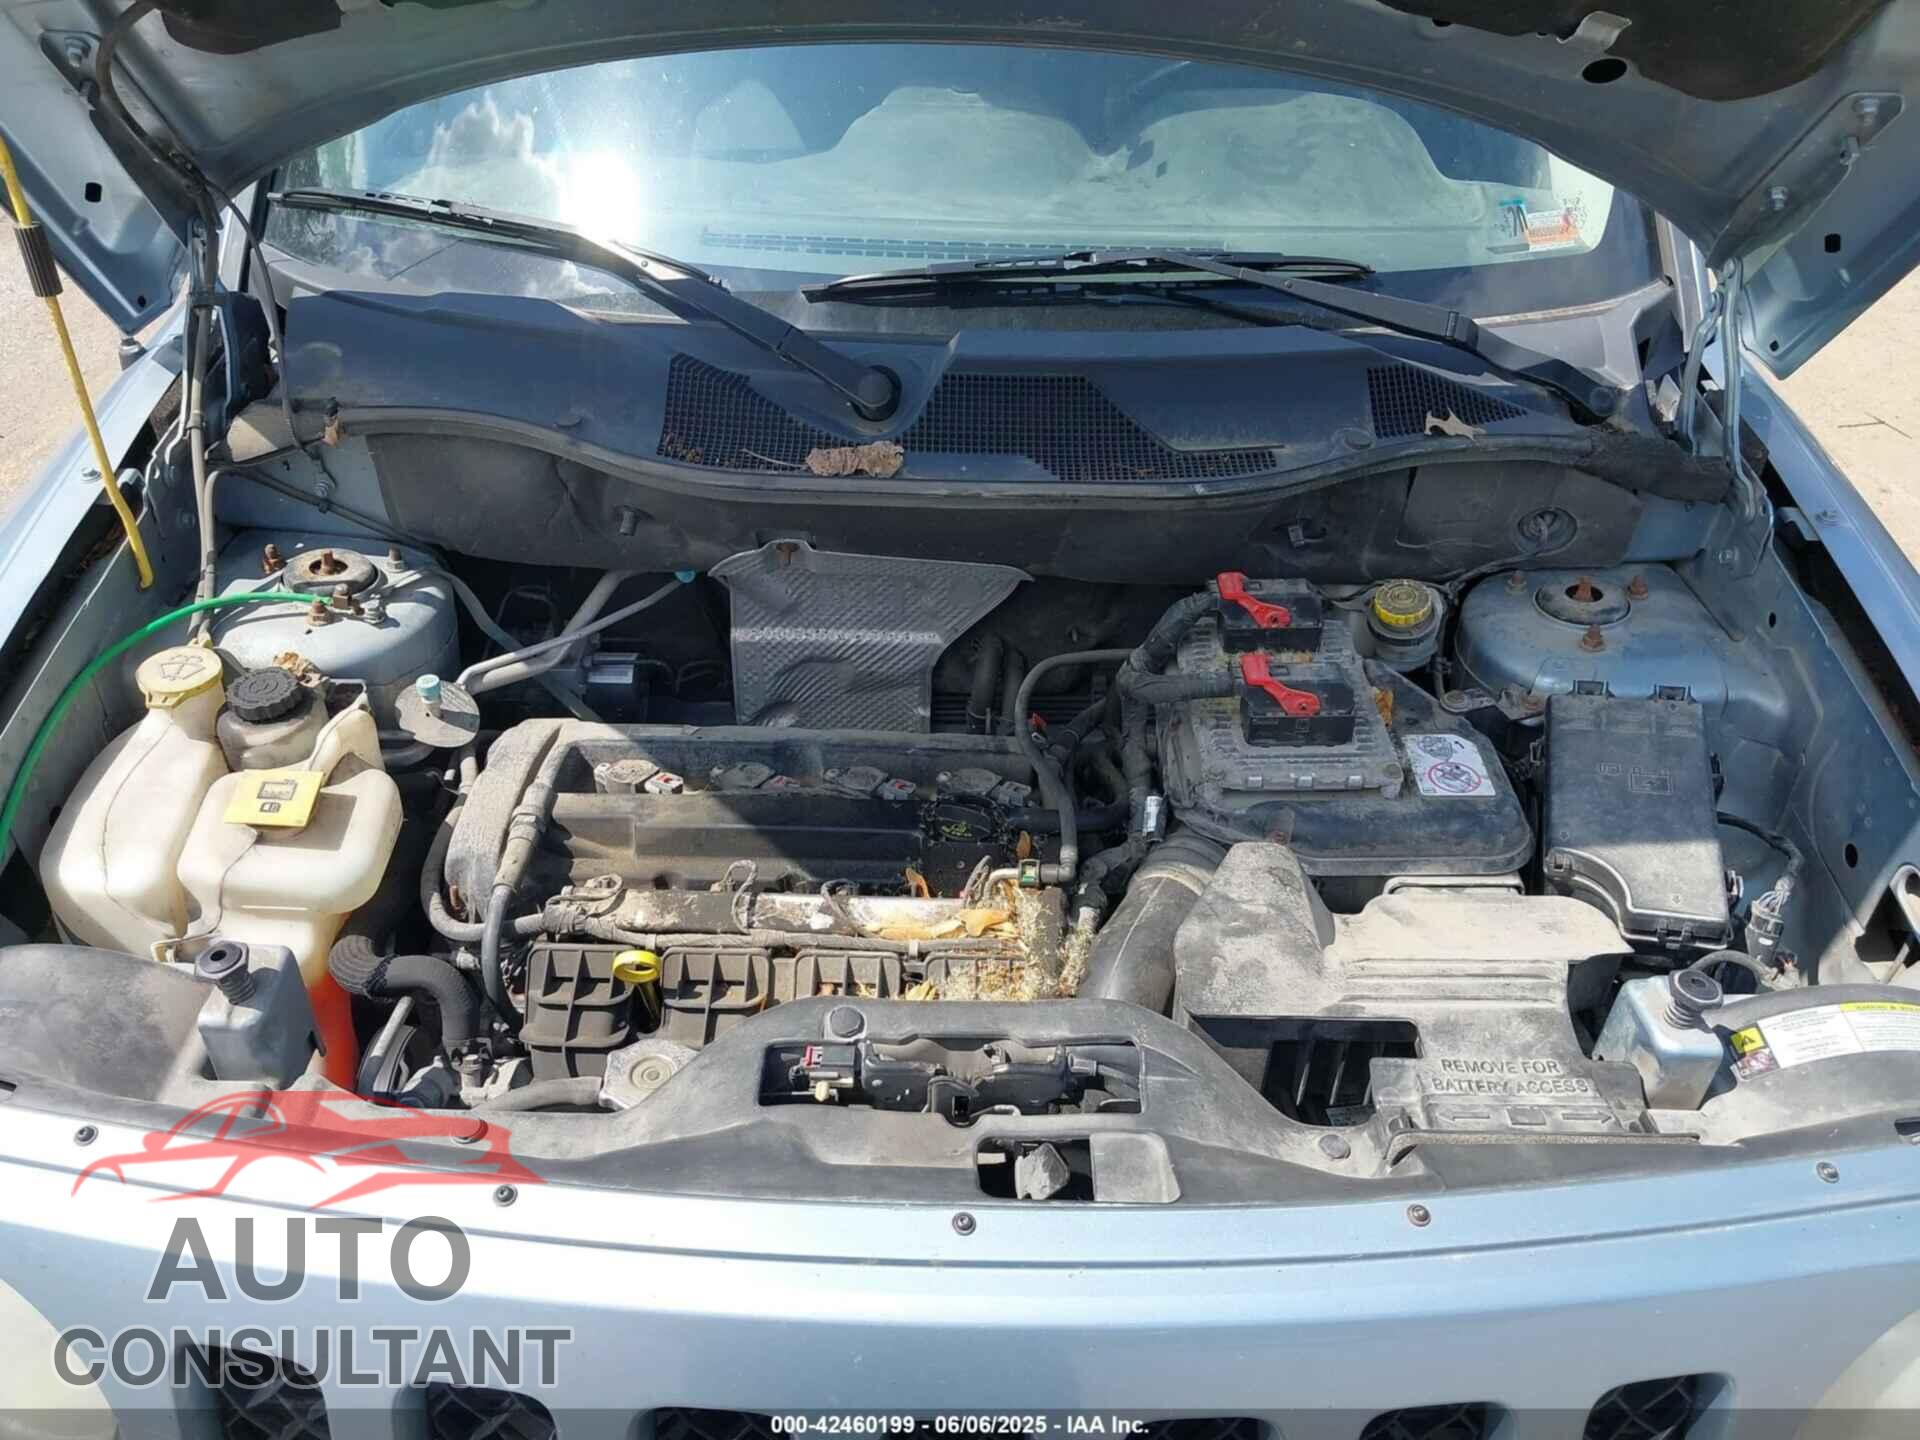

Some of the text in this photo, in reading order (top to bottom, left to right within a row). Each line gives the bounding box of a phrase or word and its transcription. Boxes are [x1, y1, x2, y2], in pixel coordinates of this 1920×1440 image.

[1440, 1058, 1560, 1074] REMOVE FOR
[1431, 1077, 1588, 1094] BATTERY ACCESS
